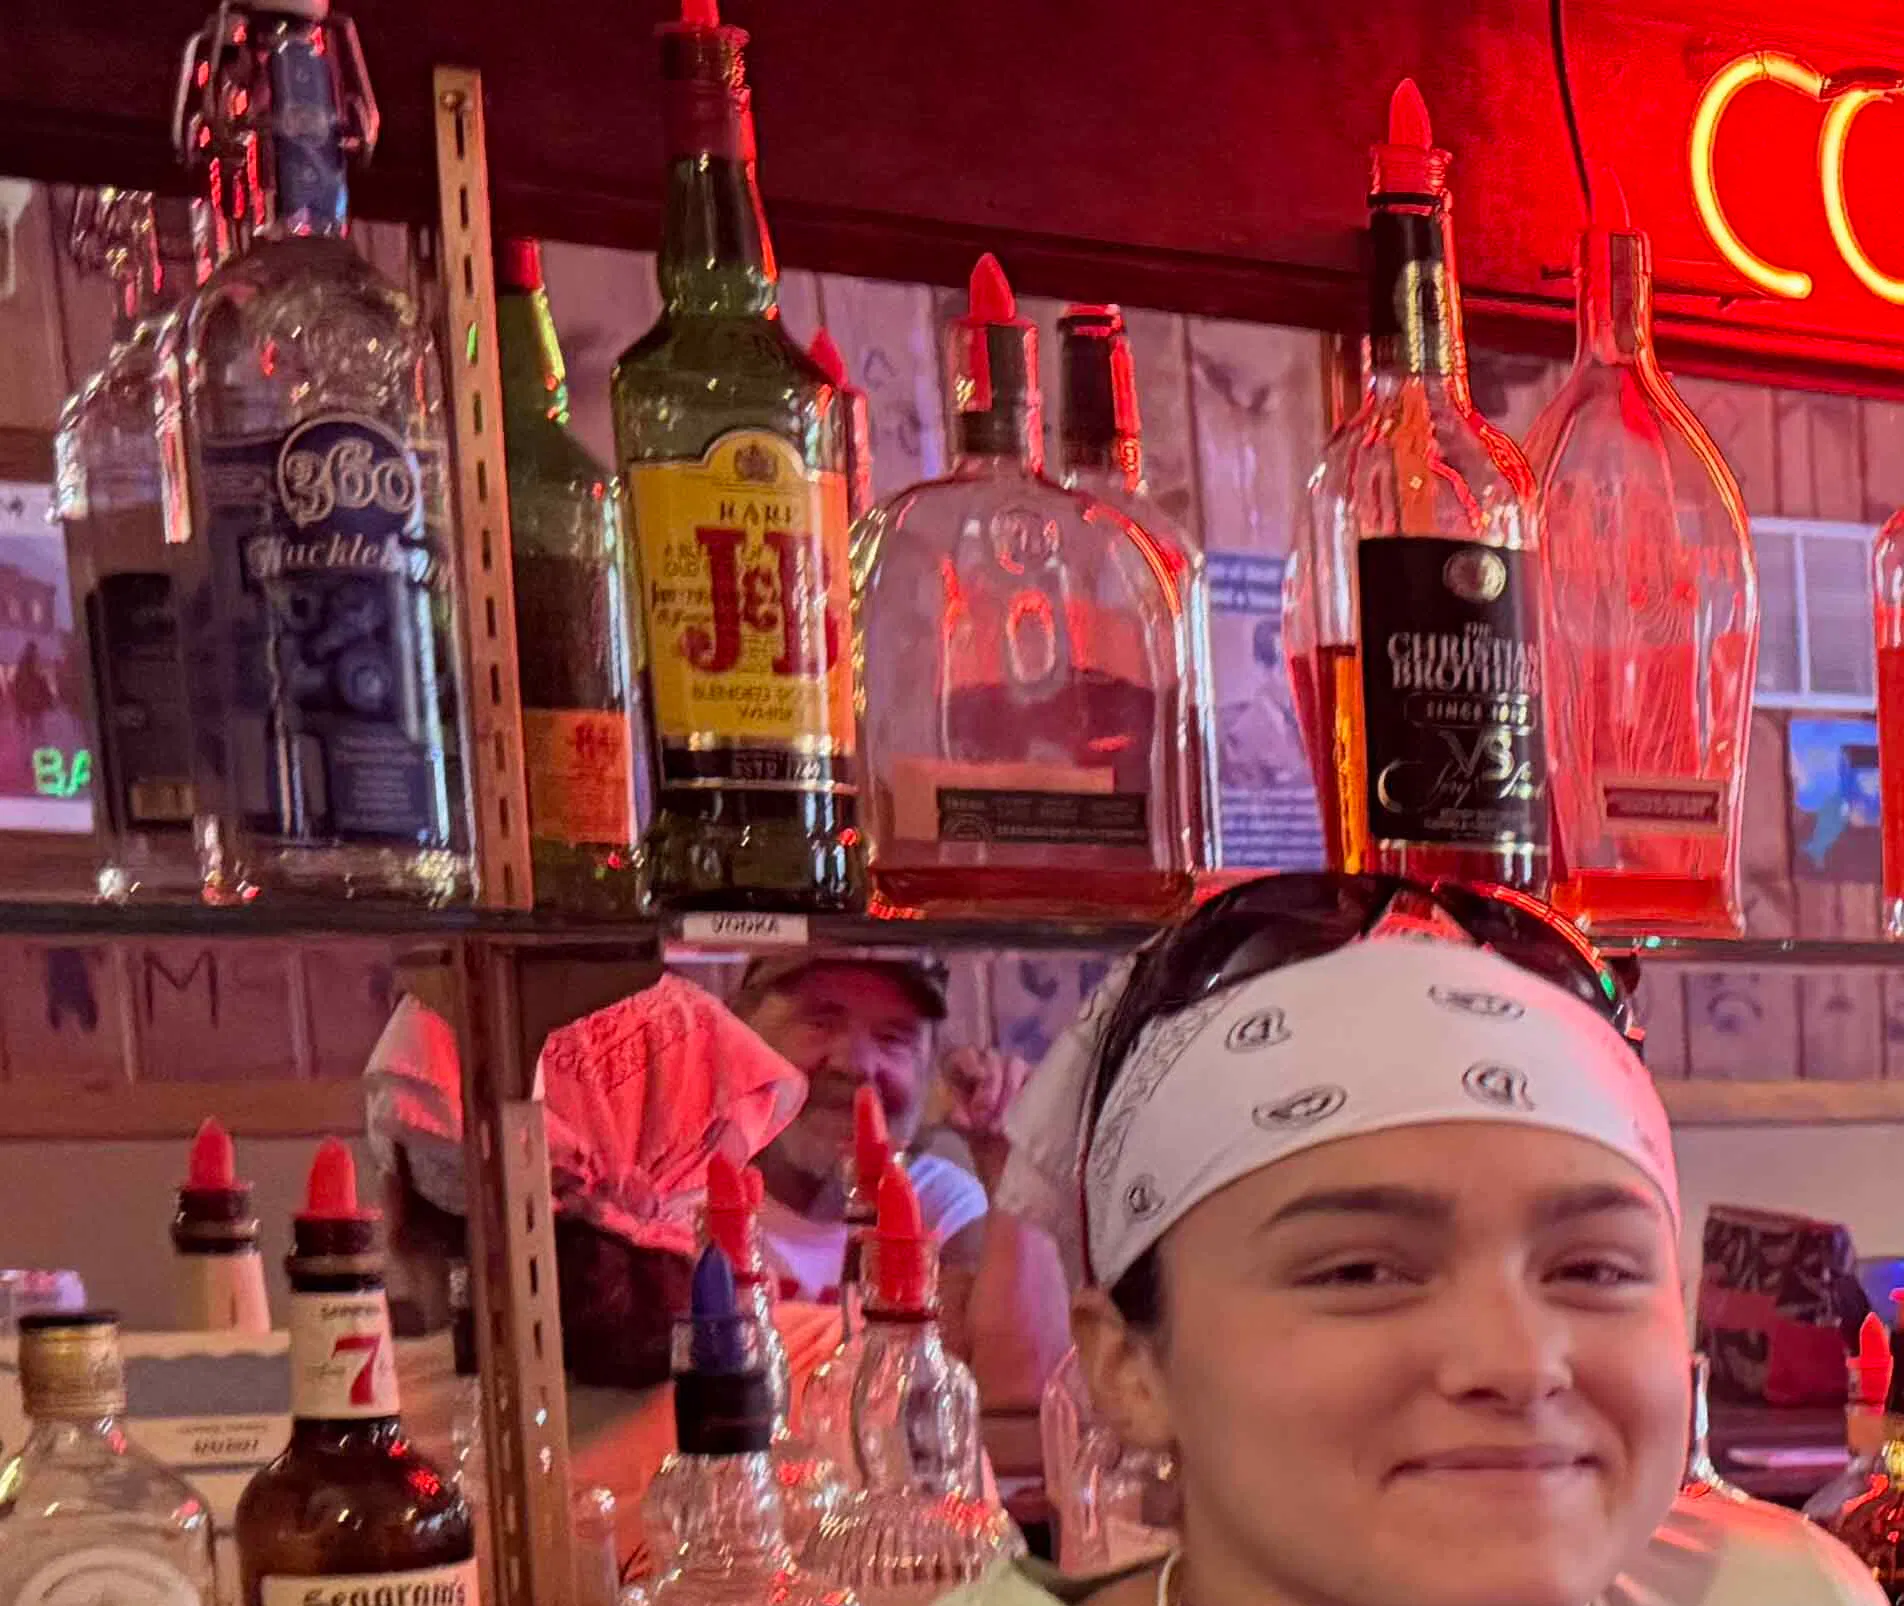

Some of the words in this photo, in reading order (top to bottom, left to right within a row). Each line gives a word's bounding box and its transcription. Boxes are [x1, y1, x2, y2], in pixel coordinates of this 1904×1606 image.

[1387, 631, 1541, 674] CHRISTIAN
[31, 746, 93, 798] BA
[331, 1334, 382, 1405] 7
